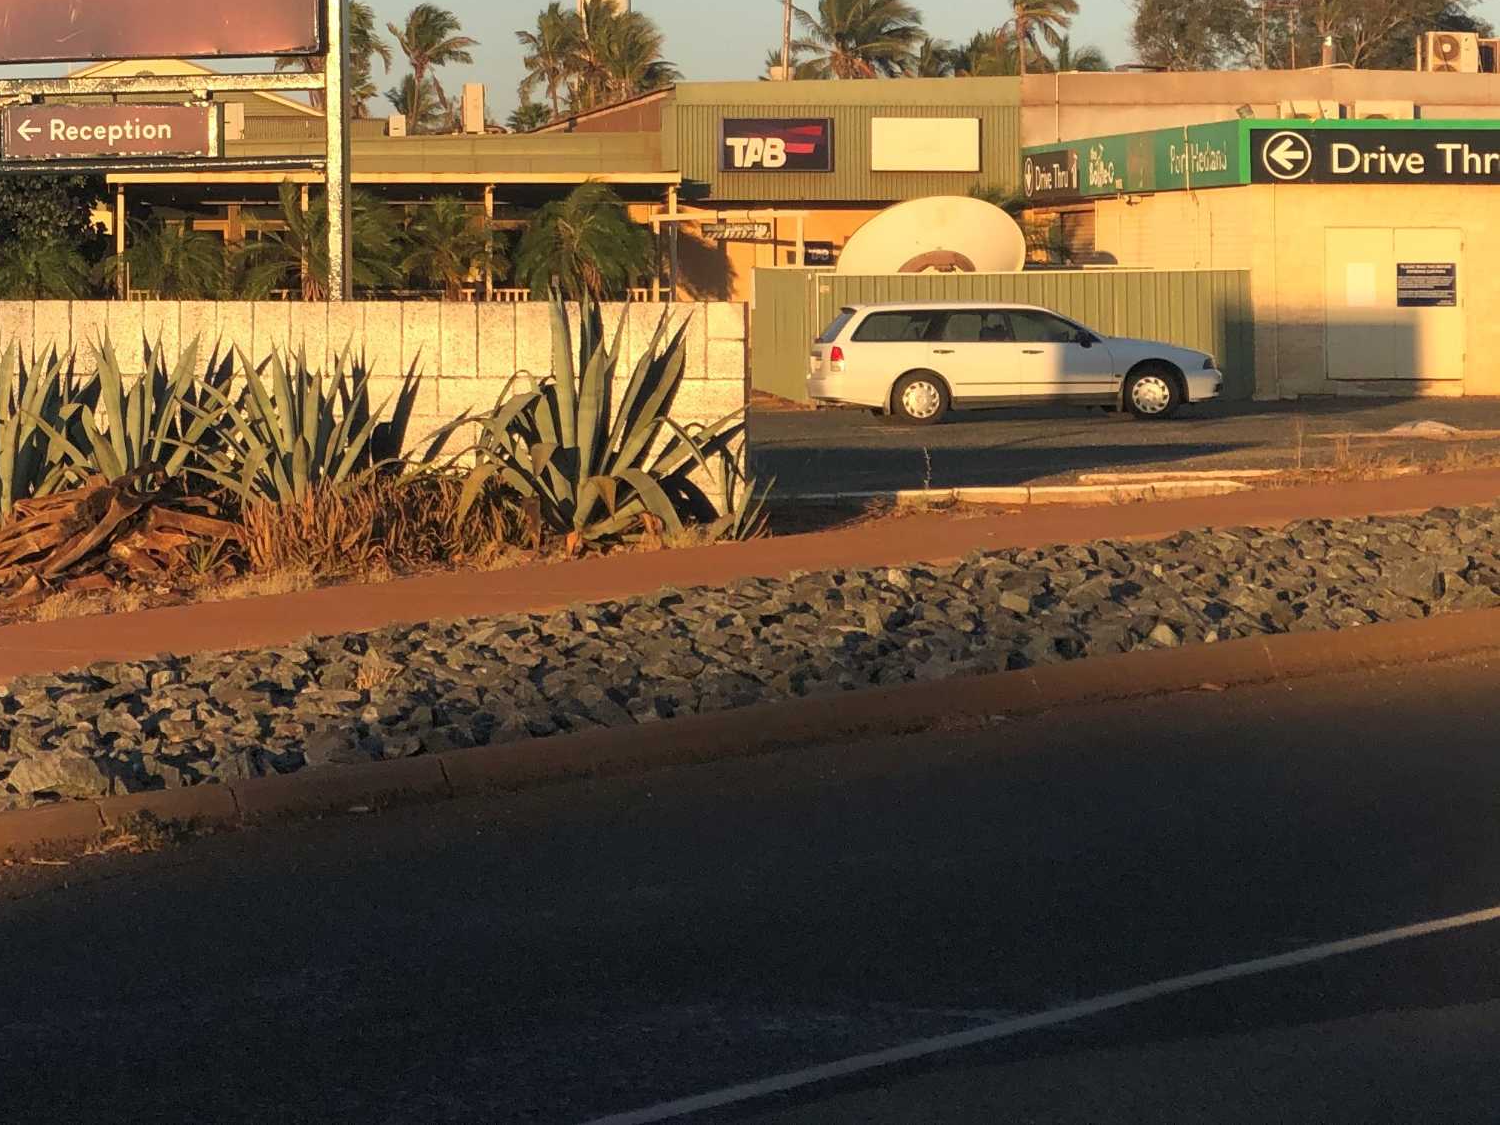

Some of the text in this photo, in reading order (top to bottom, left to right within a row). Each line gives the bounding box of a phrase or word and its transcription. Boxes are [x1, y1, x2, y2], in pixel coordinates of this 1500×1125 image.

[50, 118, 172, 146] Reception
[726, 138, 787, 168] TAB
[1331, 143, 1425, 174] Drive
